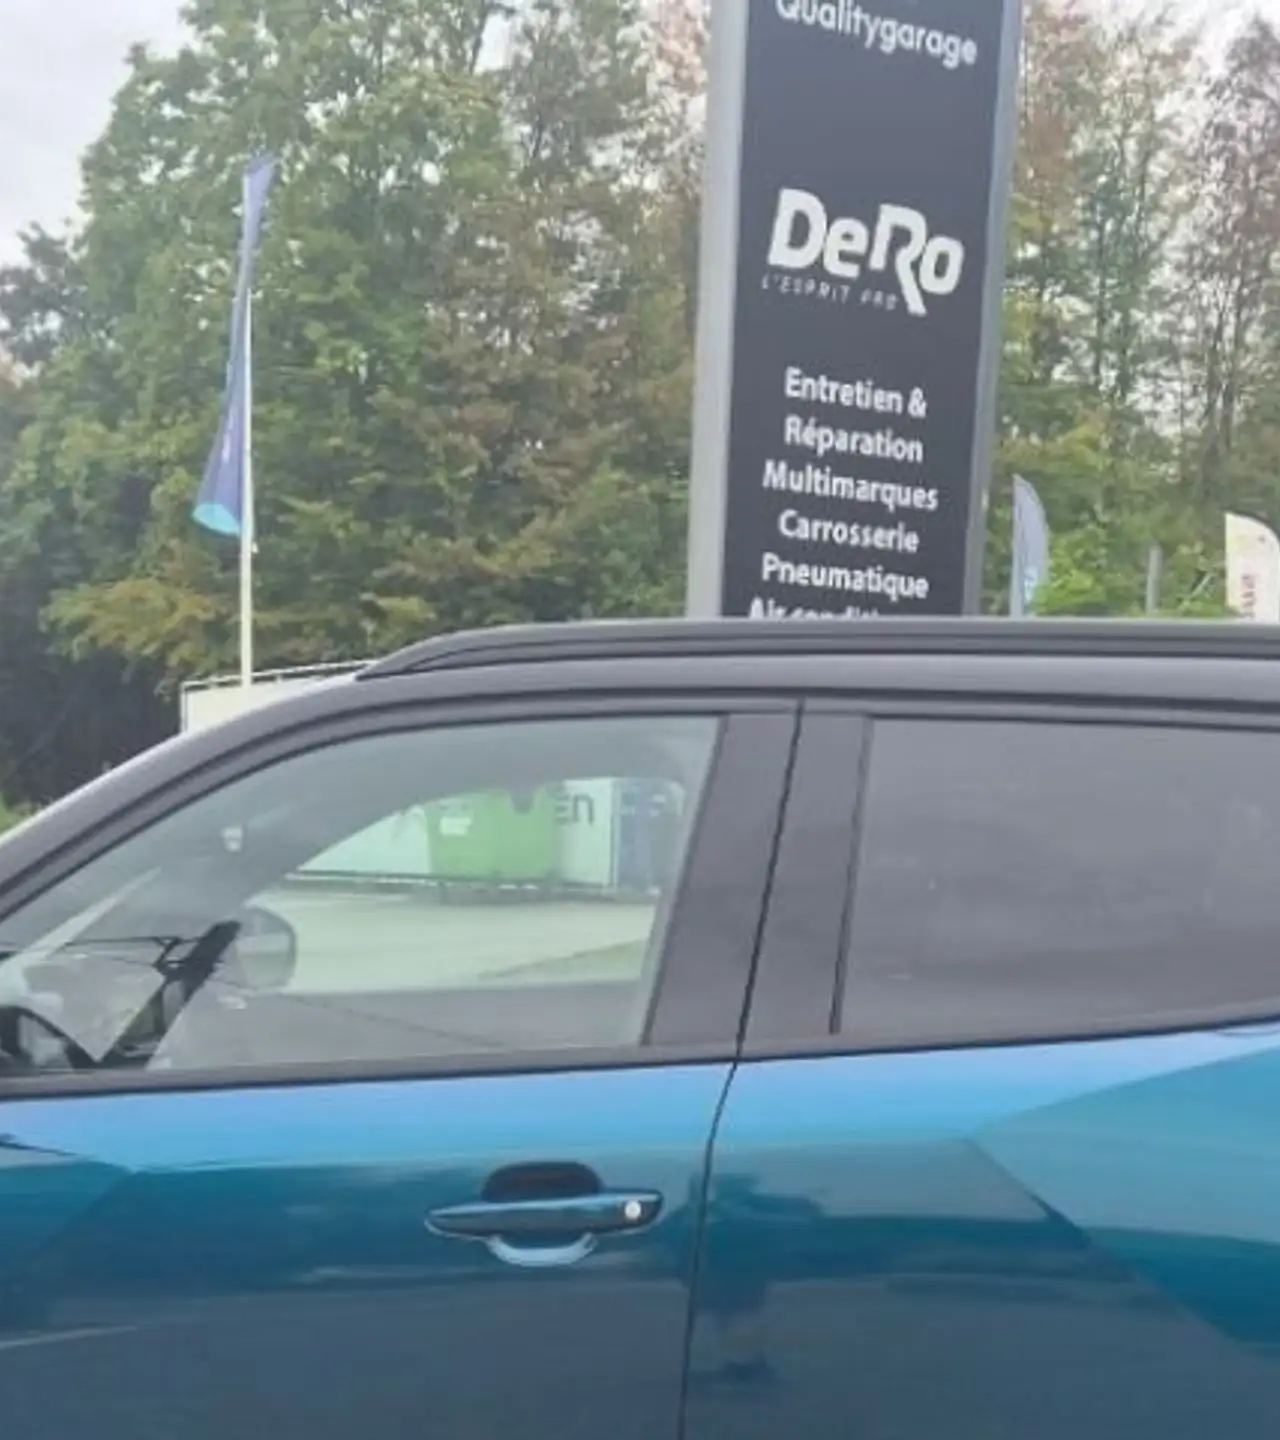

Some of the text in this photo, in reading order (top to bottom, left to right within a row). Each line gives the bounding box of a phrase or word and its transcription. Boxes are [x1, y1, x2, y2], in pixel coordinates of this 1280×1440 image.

[775, 0, 979, 69] Qualitygarage
[767, 187, 966, 317] DeRo
[784, 366, 928, 418] Entretien &
[784, 413, 924, 463] Réparation
[763, 460, 940, 512] Multimarques
[778, 509, 920, 554] Carrosserie
[762, 552, 930, 601] Pneumatique
